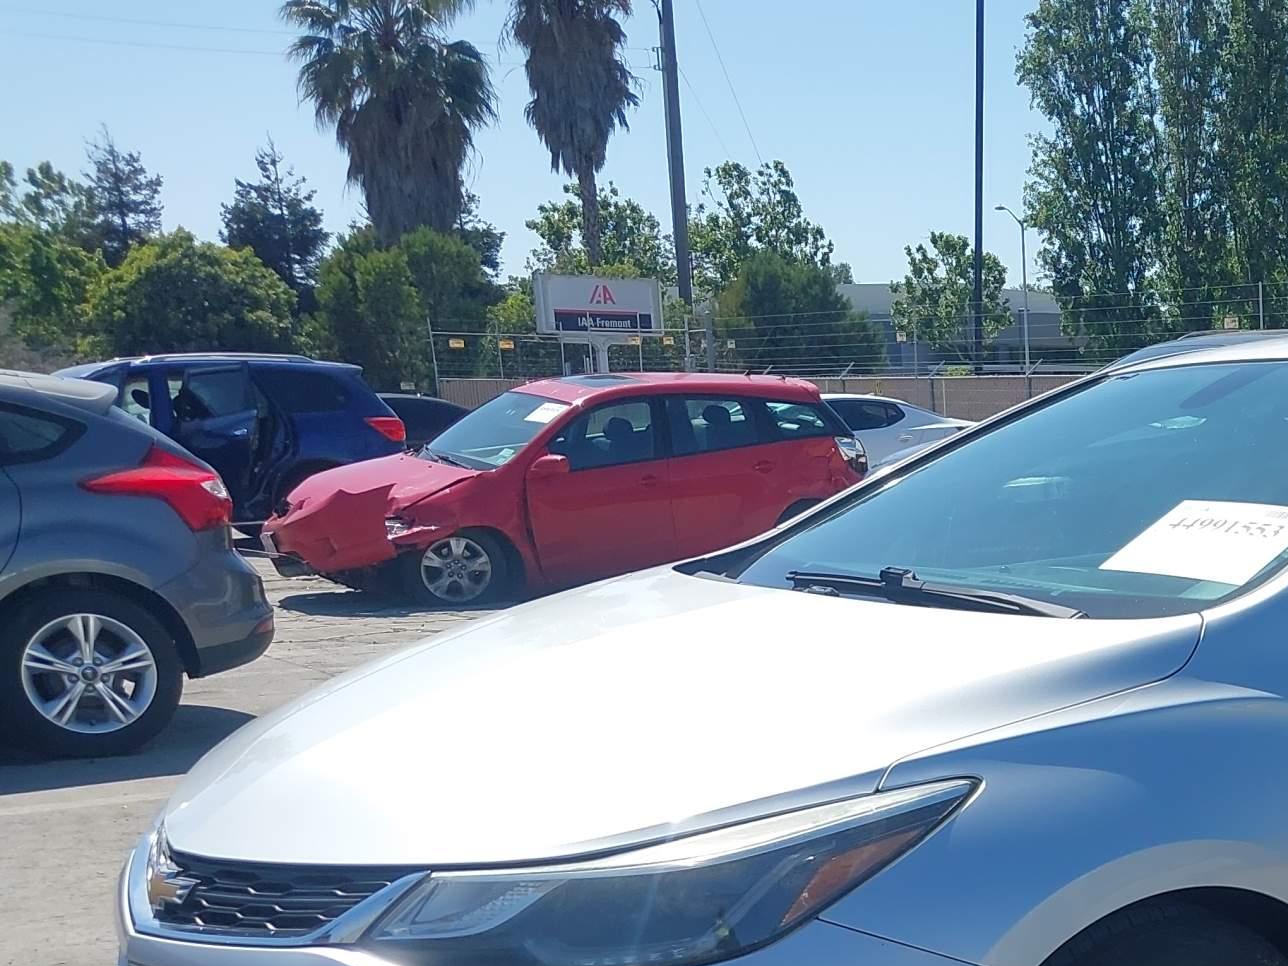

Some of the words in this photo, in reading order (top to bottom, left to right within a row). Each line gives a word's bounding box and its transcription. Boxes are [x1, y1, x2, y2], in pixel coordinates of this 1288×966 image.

[578, 317, 594, 327] IAA
[596, 317, 631, 328] Fremont
[1168, 516, 1286, 539] 44991553
